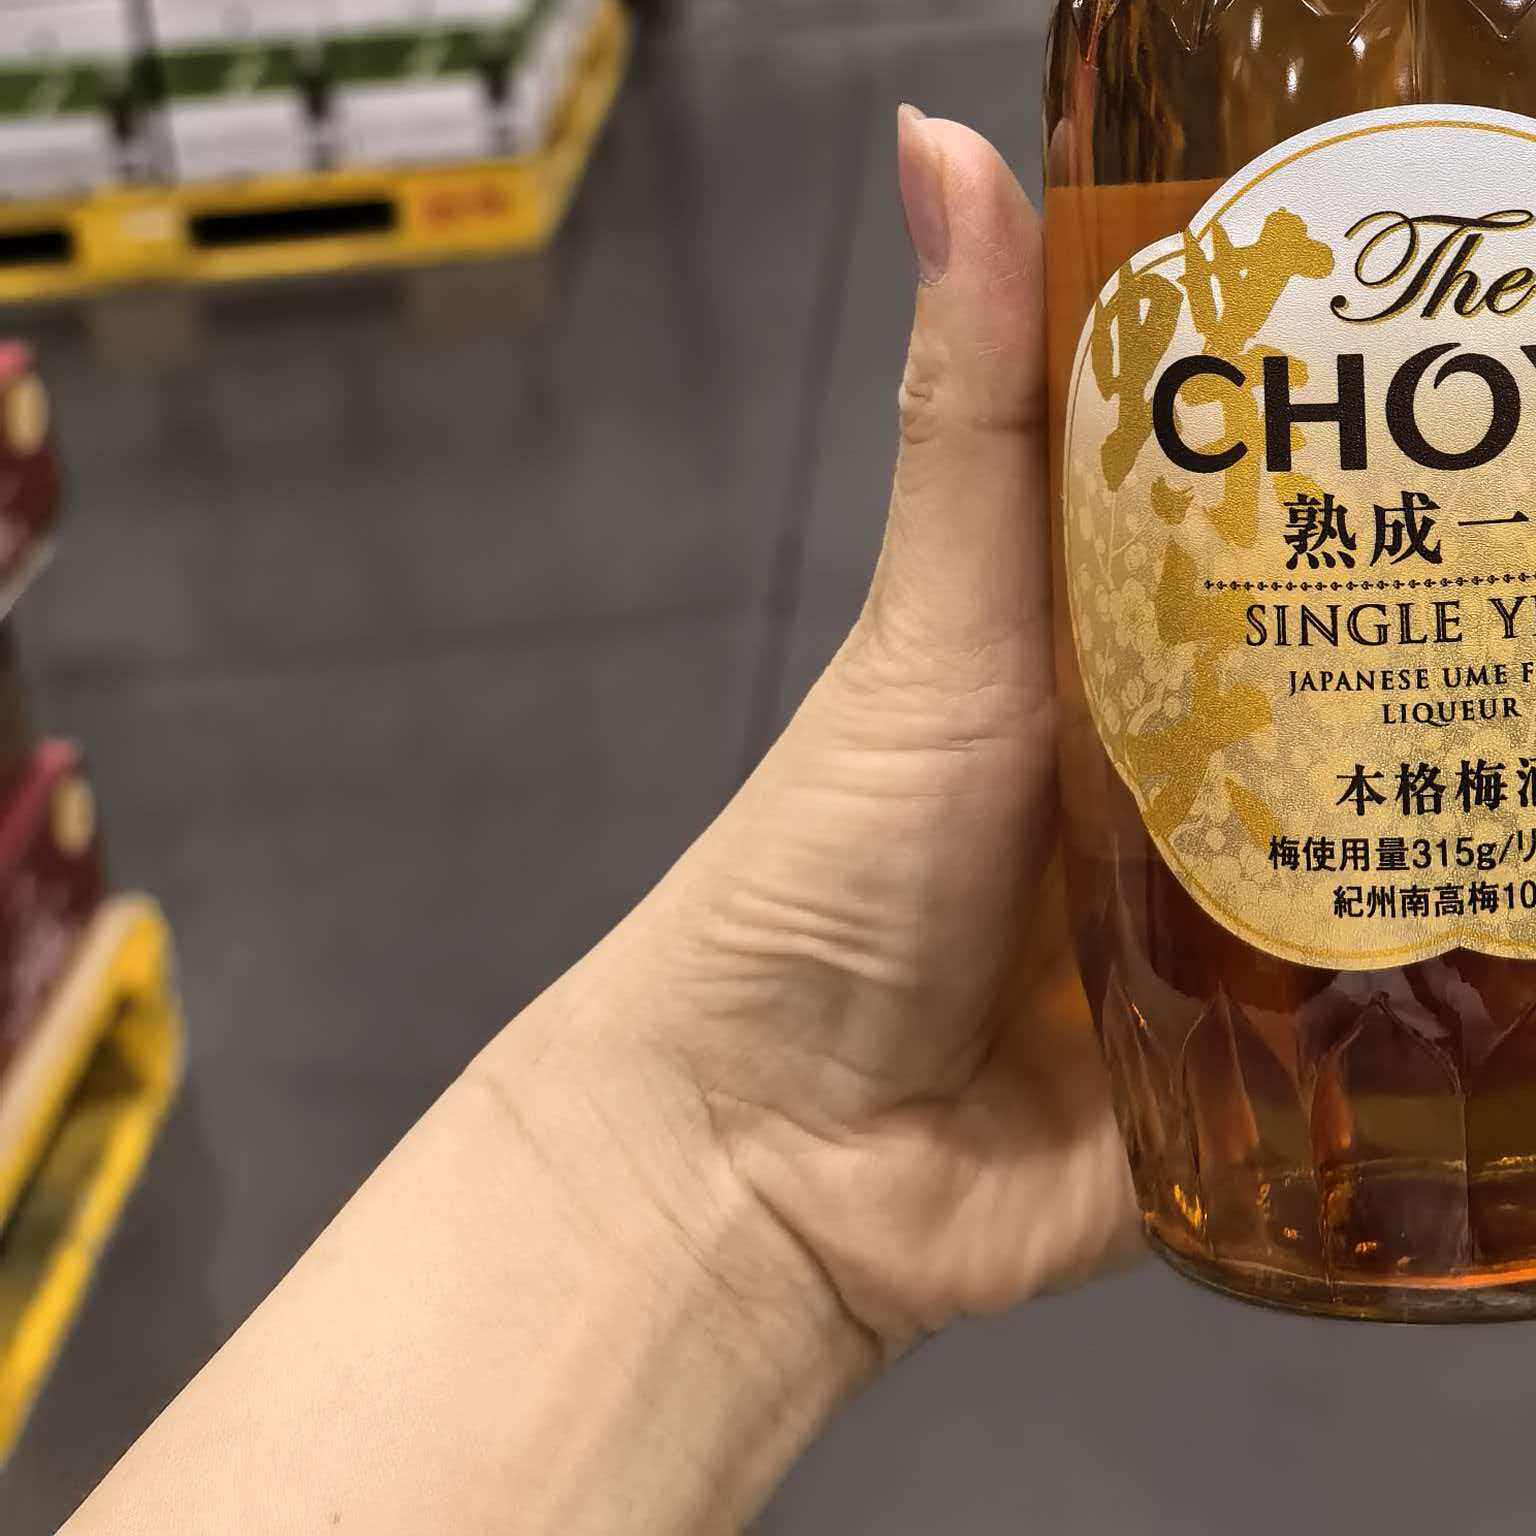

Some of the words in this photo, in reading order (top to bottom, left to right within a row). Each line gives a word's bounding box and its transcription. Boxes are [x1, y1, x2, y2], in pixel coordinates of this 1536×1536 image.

[1245, 598, 1464, 647] SINGLE
[1288, 667, 1430, 696] JAPANESE
[1442, 663, 1508, 689] UME
[1382, 696, 1523, 727] LIQUEUR
